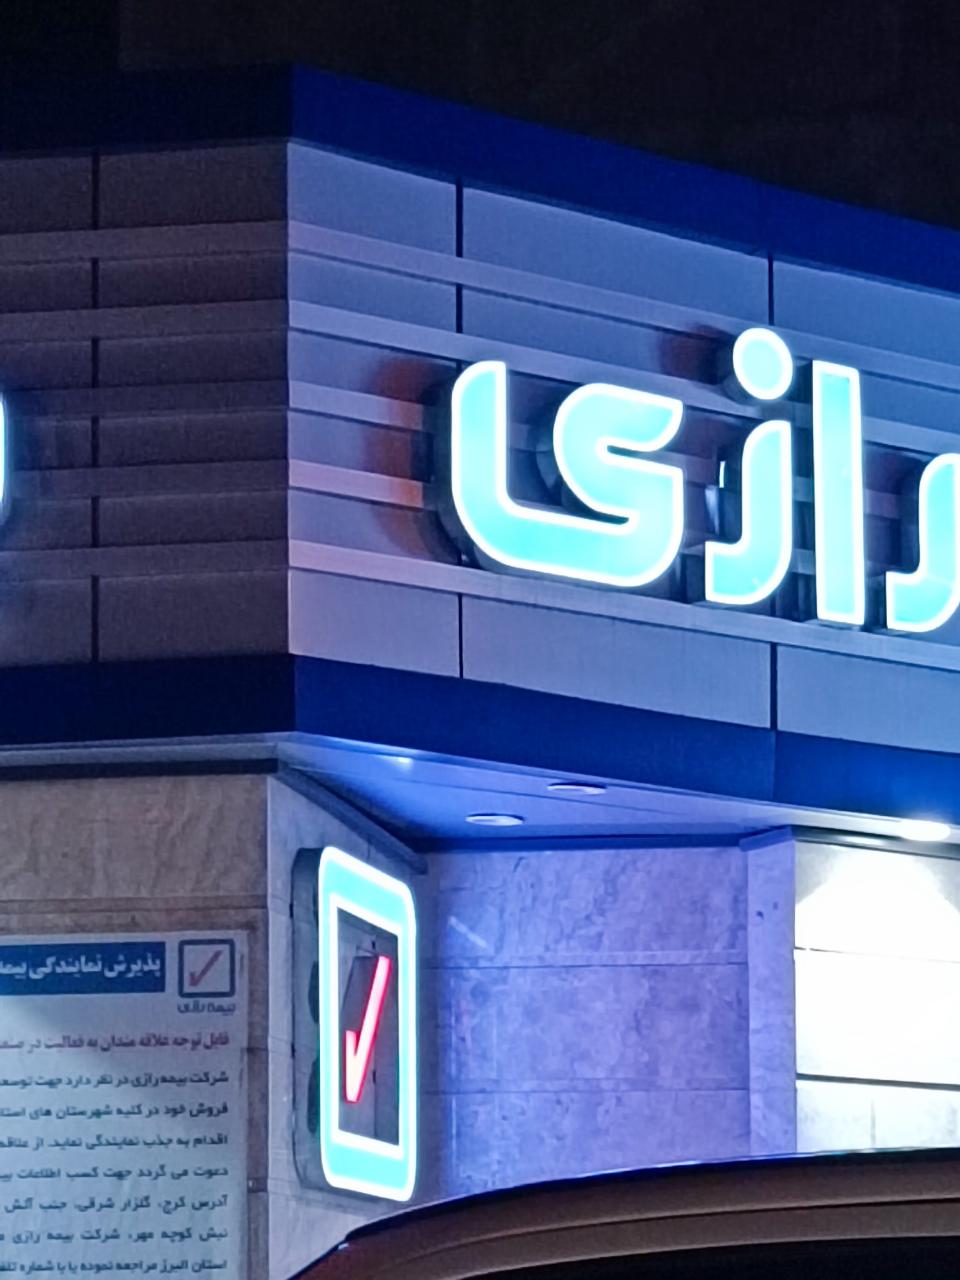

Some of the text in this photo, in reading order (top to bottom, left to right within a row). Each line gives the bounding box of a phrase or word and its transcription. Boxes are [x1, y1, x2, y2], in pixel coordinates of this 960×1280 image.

[28, 953, 102, 980] نمایندگی
[103, 953, 161, 979] پذیرش
[177, 999, 236, 1017] بیمه رازی
[35, 1075, 63, 1089] جهت
[65, 1074, 91, 1088] دارد
[131, 1072, 159, 1088] رازی
[160, 1075, 187, 1087] بیمه
[189, 1071, 230, 1086] شرکت
[29, 1106, 52, 1120] های
[56, 1104, 113, 1120] شهرستان
[145, 1105, 160, 1118] در
[163, 1103, 186, 1118] خود
[189, 1101, 229, 1118] فروش
[32, 1136, 44, 1151] از
[85, 1134, 140, 1150] نمایندگی
[143, 1135, 173, 1149] جذب
[176, 1137, 190, 1149] به
[193, 1133, 228, 1149] اقدام
[17, 1167, 61, 1179] اطلاعات
[66, 1166, 99, 1181] کسب
[103, 1167, 132, 1180] جهت
[193, 1166, 229, 1179] دعوت
[39, 1200, 67, 1212] جنب
[191, 1193, 229, 1210] آدرس
[12, 1230, 41, 1244] رازی
[46, 1232, 74, 1244] بیمه
[80, 1228, 121, 1243] شرکت
[161, 1226, 193, 1243] کوچه
[198, 1226, 229, 1241] نبش
[20, 1259, 54, 1275] شماره
[80, 1260, 113, 1273] نموده
[115, 1259, 158, 1273] مراجعه
[159, 1258, 188, 1273] البرز
[191, 1258, 227, 1273] استان
